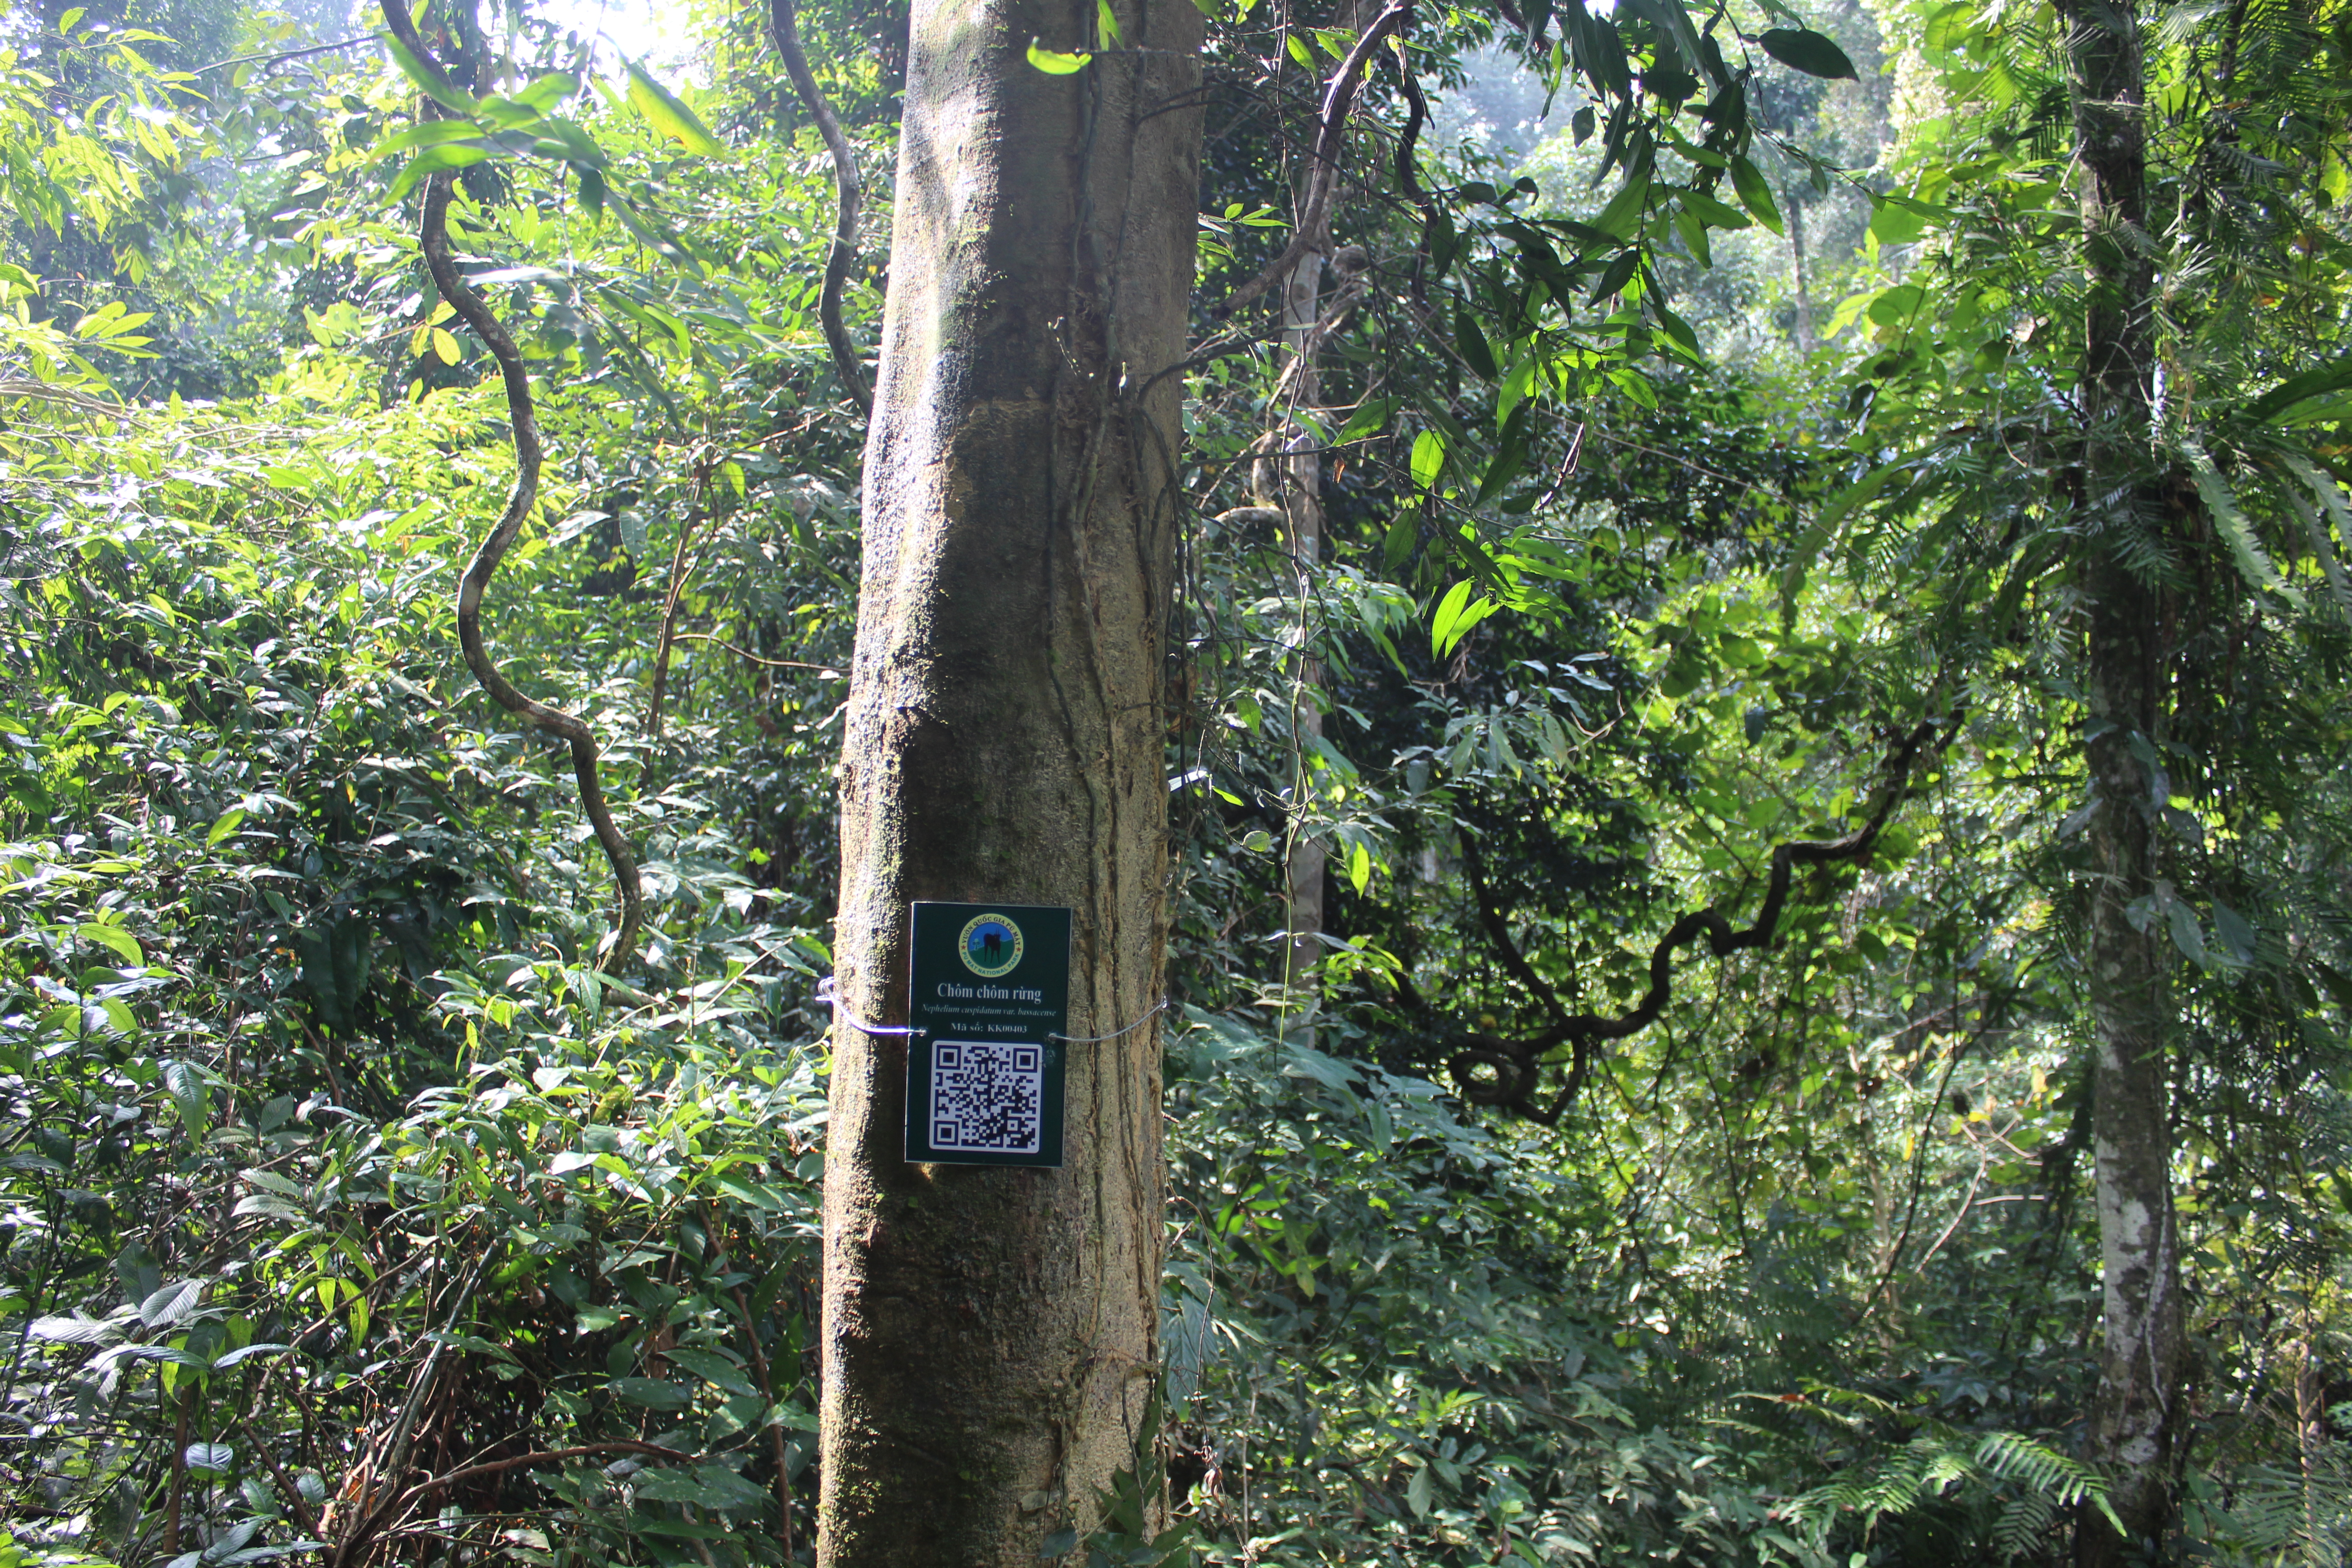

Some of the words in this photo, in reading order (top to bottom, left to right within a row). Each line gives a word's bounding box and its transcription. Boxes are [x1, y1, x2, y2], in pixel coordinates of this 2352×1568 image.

[973, 915, 991, 926] QUỐC
[966, 960, 977, 970] MAT
[1008, 954, 1019, 968] PARK
[937, 983, 973, 998] Chôm
[976, 985, 1009, 1000] chôm
[1013, 986, 1041, 1004] rừng
[921, 1004, 959, 1013] Nephelium
[961, 1006, 1001, 1016] cuspidatum
[1018, 1007, 1056, 1016] bassacense
[951, 1022, 966, 1031] Mã
[970, 1022, 983, 1032] số:
[988, 1024, 1027, 1033] KK00403
